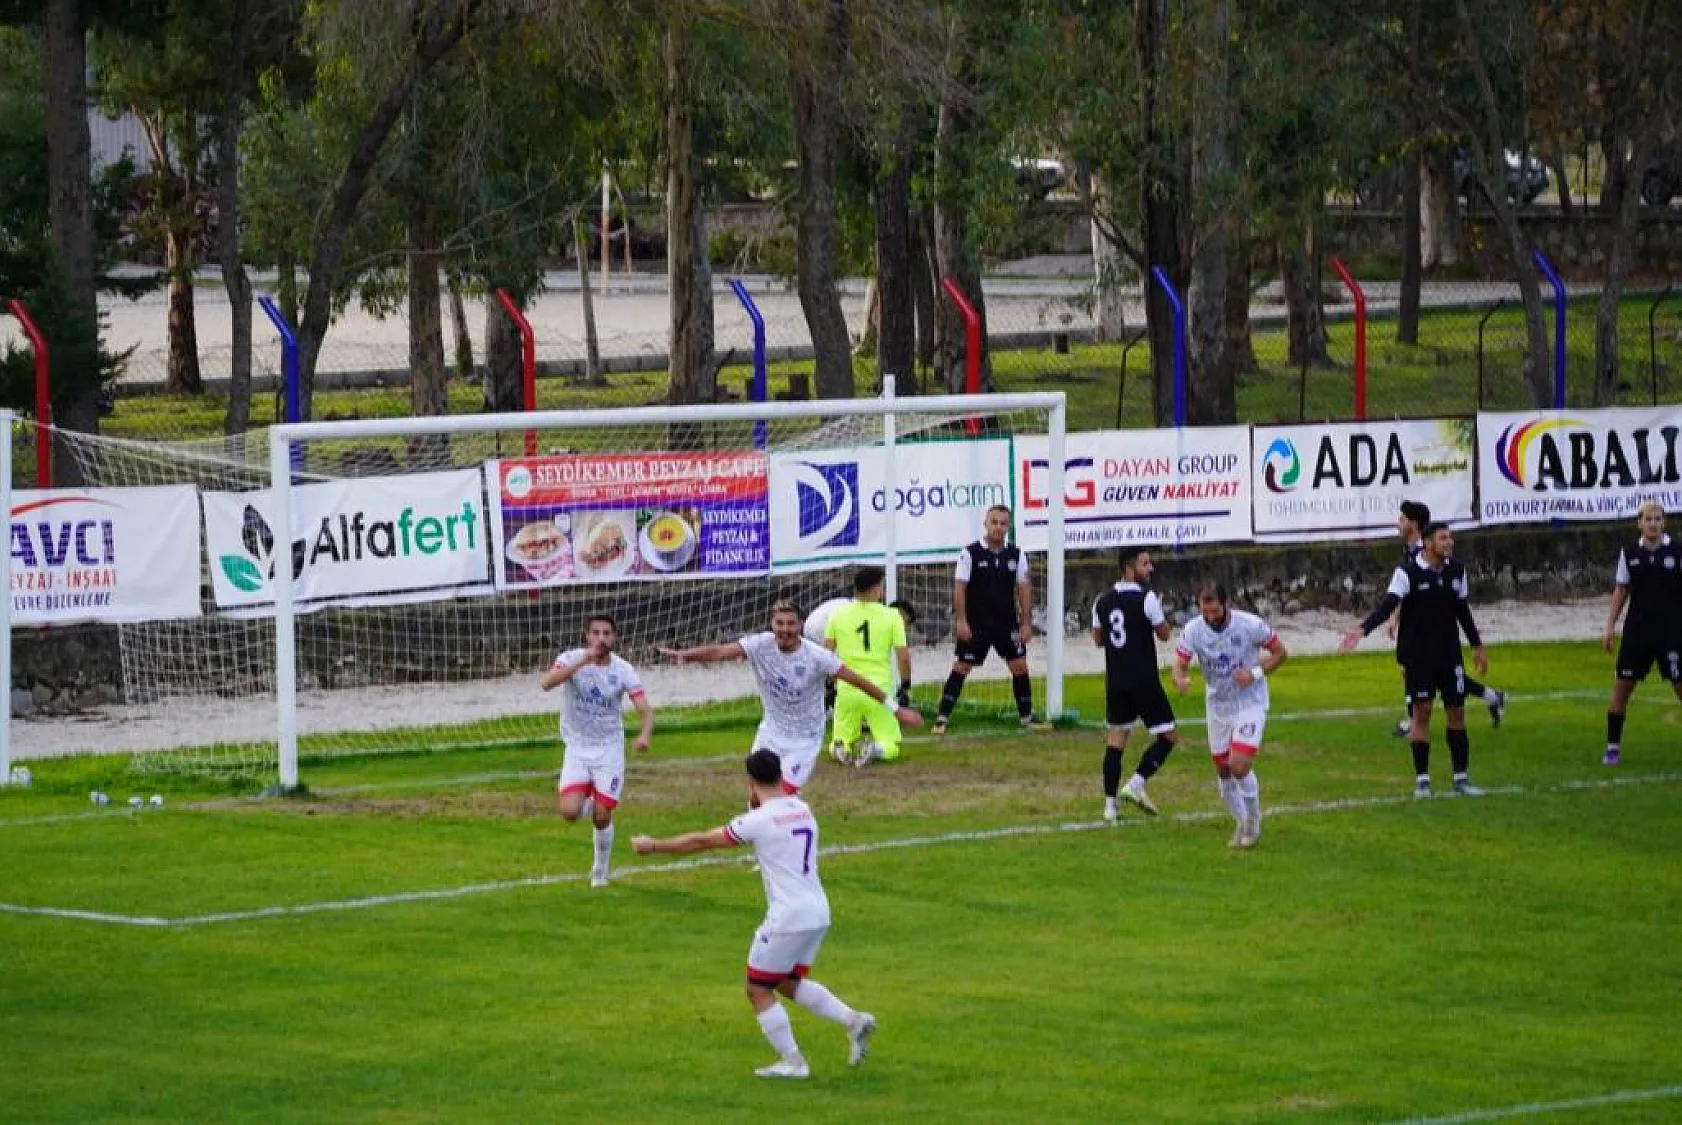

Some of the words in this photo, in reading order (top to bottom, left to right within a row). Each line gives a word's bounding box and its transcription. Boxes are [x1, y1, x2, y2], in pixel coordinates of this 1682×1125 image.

[1104, 457, 1170, 478] DAYAN
[1178, 453, 1238, 475] GROUP
[1312, 433, 1410, 489] ADA
[1533, 425, 1681, 491] ABALI
[1104, 482, 1159, 502] GÜVEN
[1163, 478, 1240, 499] NAKLİYAT
[1485, 500, 1510, 518] OTO
[11, 519, 115, 567] AVCI
[310, 501, 477, 565] Alfafert
[856, 620, 870, 651] 1
[1108, 608, 1128, 649] 3
[791, 827, 813, 875] 7
